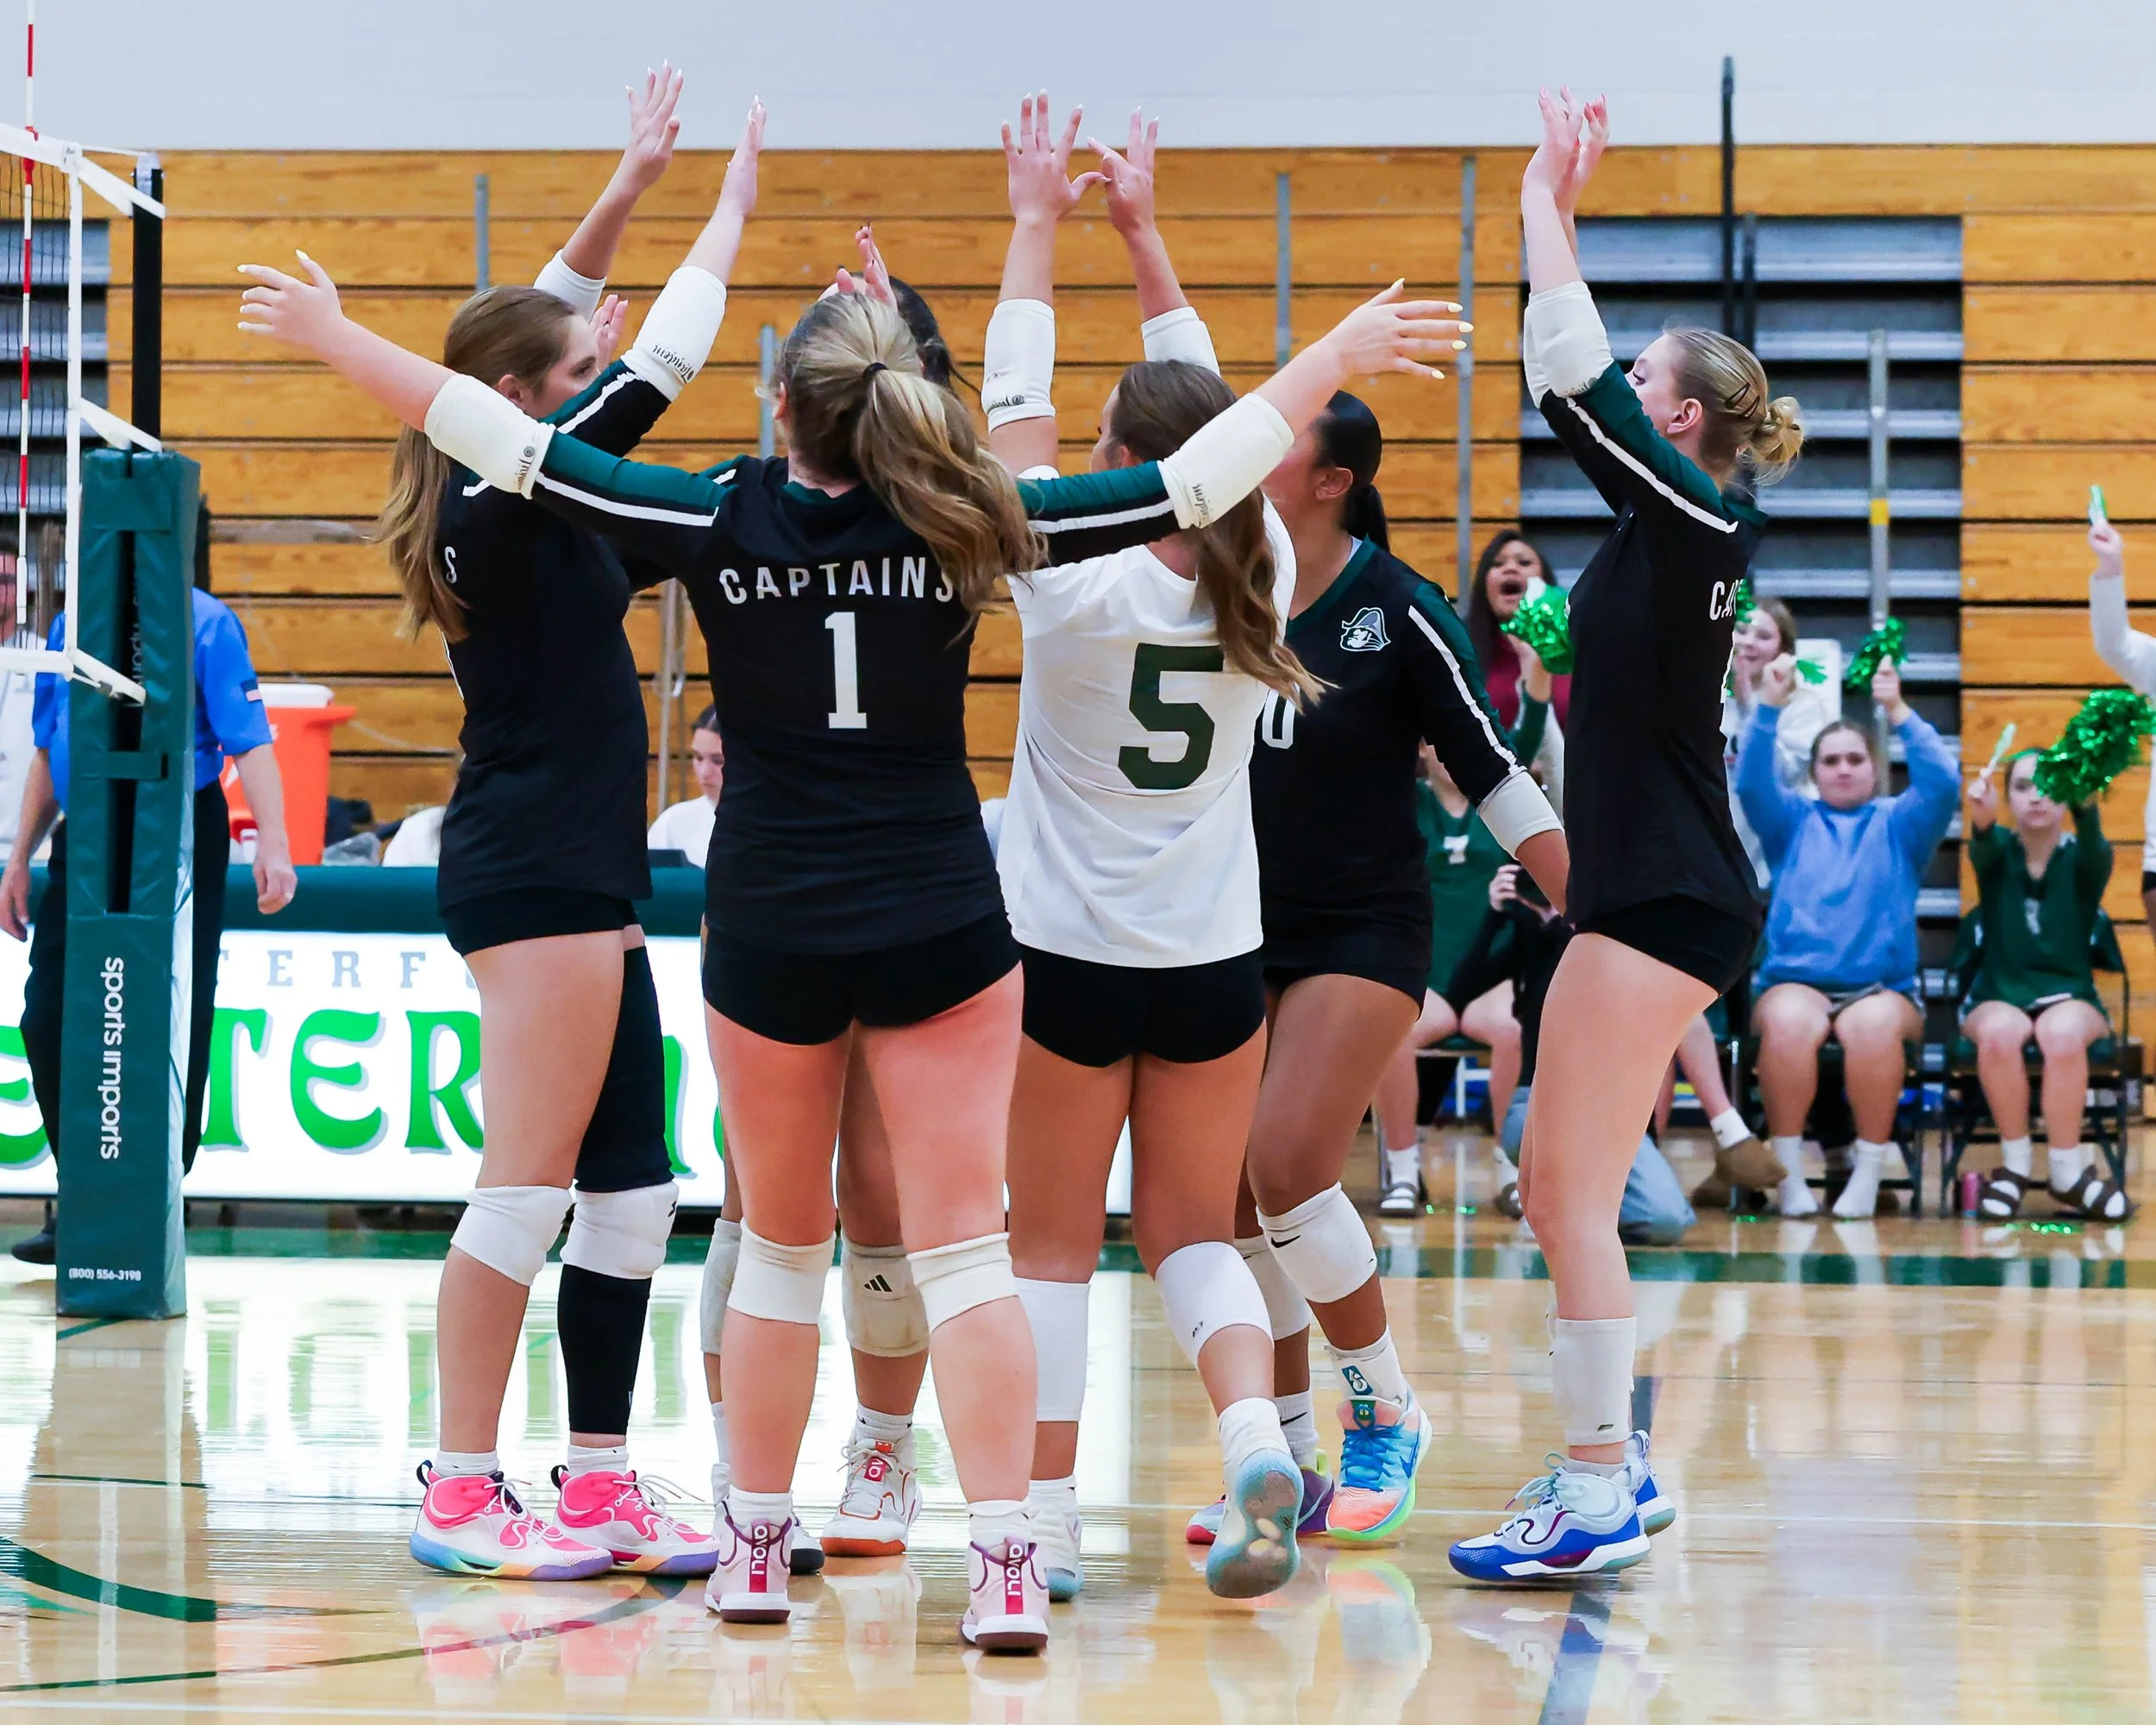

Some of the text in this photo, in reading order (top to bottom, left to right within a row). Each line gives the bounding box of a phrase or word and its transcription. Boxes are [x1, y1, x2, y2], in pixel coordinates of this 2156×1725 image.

[824, 612, 868, 729] 1
[1118, 642, 1225, 790] 5
[100, 957, 126, 1046] sports
